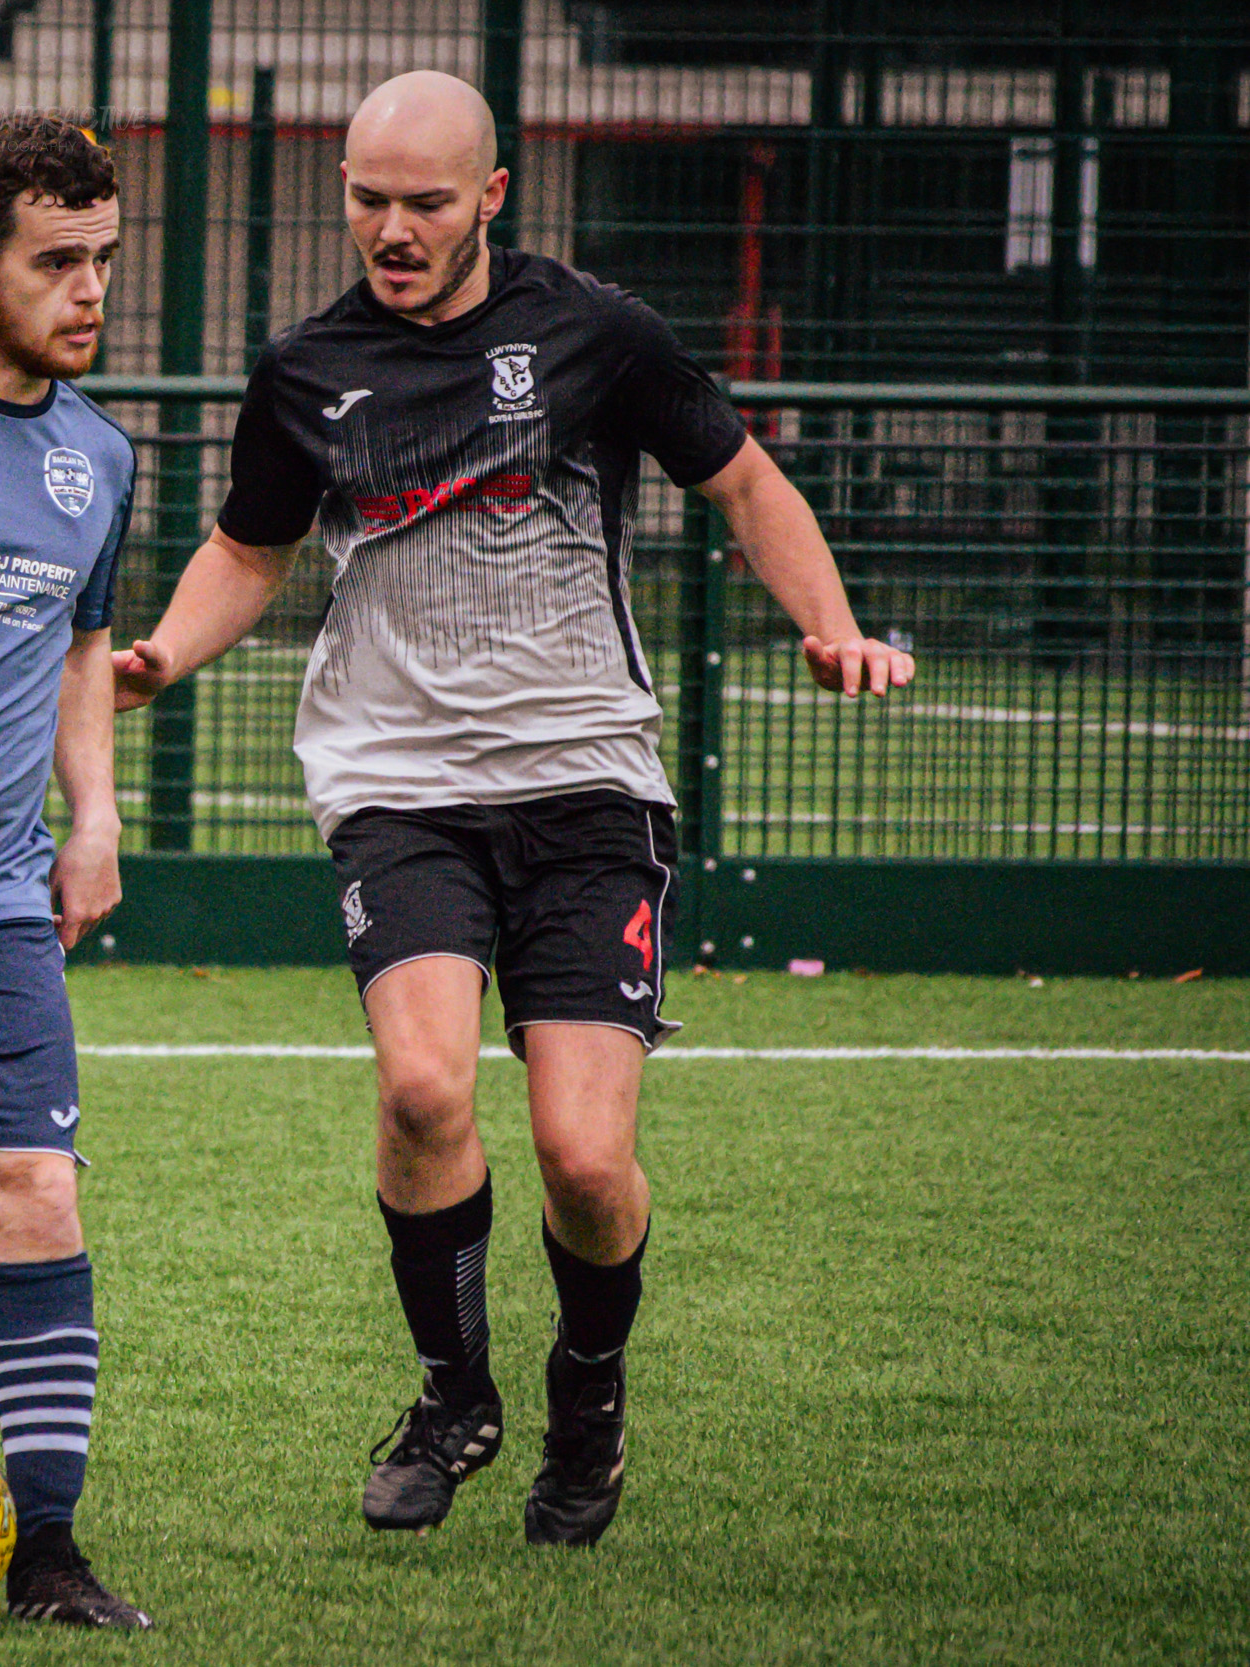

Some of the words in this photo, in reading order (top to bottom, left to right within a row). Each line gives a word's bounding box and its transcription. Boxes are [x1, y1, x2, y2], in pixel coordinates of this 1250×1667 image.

[485, 343, 538, 360] LLWYNYPIA
[11, 557, 77, 583] PROPERTY
[623, 899, 653, 972] 4
